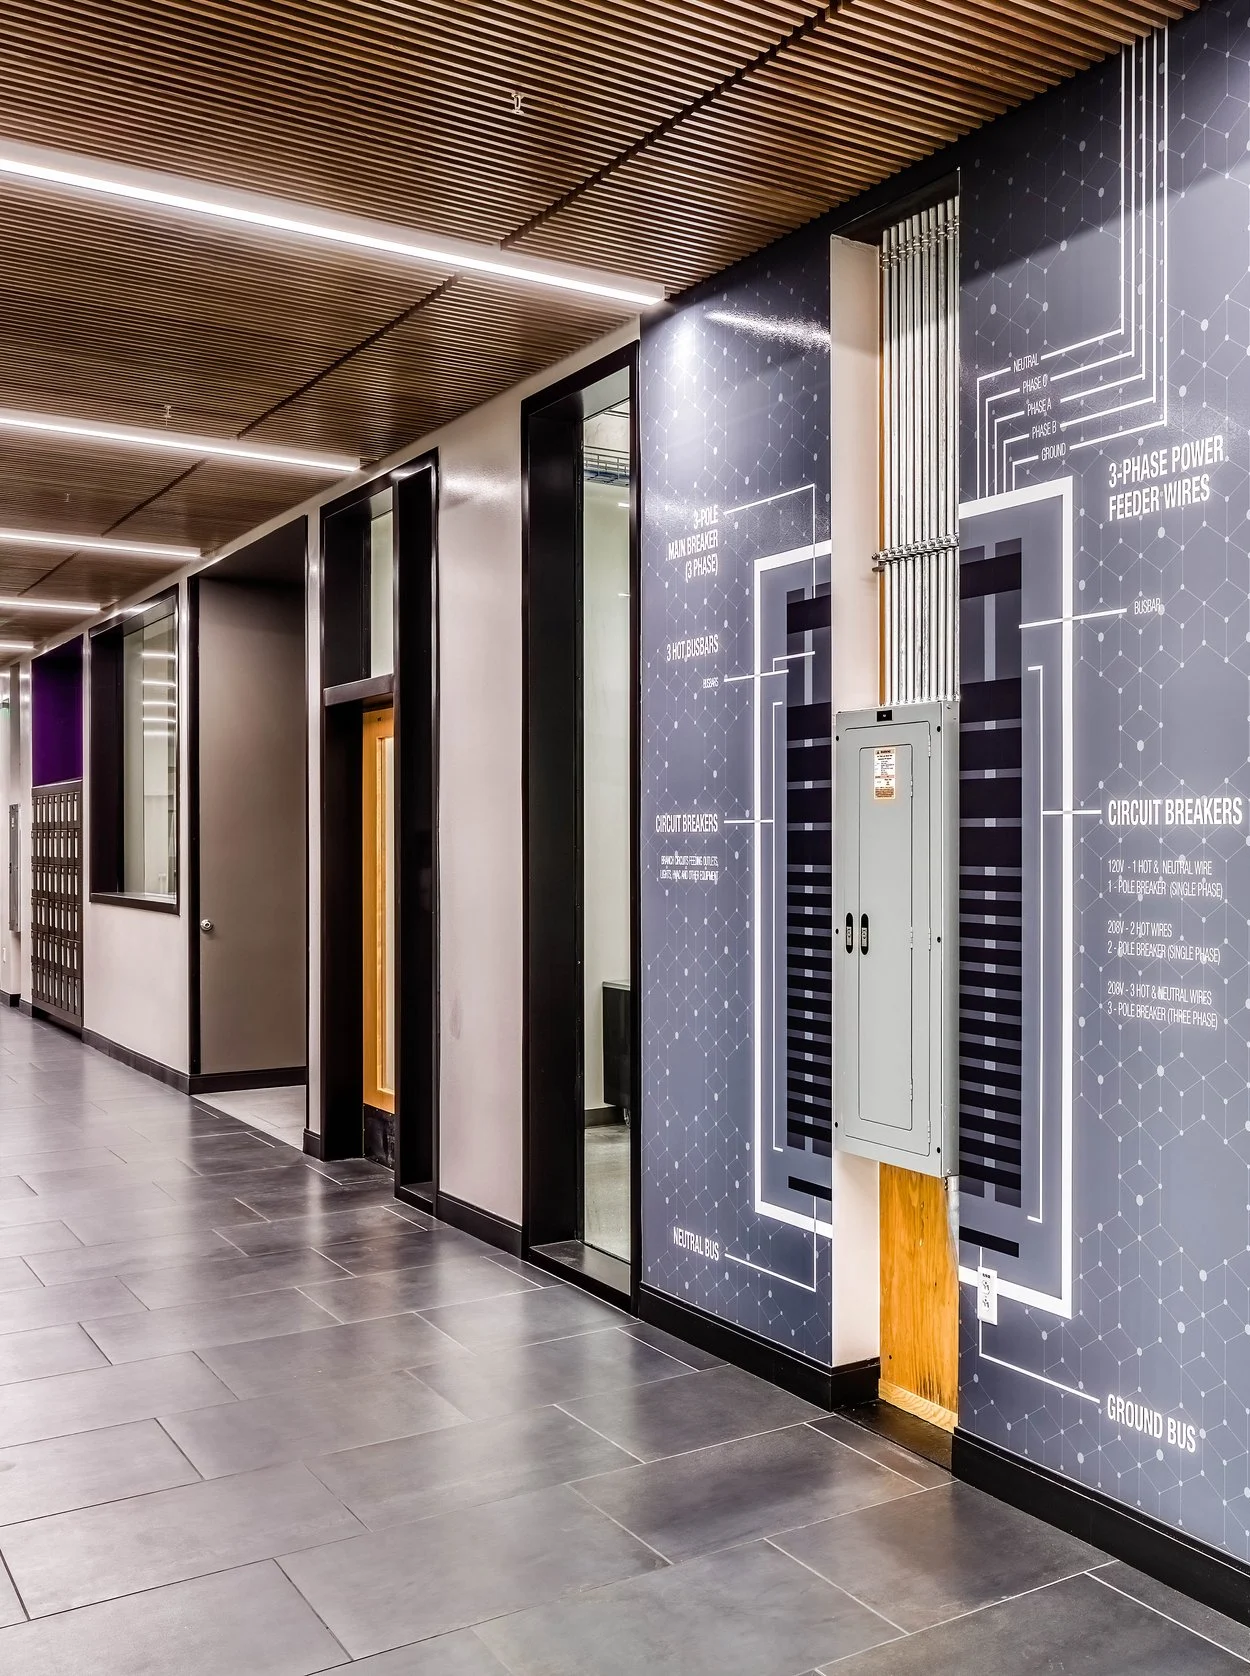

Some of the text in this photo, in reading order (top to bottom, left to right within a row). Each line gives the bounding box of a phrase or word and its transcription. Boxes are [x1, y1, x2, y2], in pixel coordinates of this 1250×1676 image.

[1014, 353, 1039, 372] NEUTRAL
[1022, 376, 1042, 394] PHASE
[1028, 397, 1052, 416] PHASE A
[1032, 420, 1056, 440] PHASE B
[1041, 442, 1066, 461] GROUND
[1108, 434, 1224, 488] 3-PHASE POWER
[1109, 474, 1210, 522] FEEDER WIRES
[694, 504, 718, 530] 3-POLE
[668, 529, 718, 560] MAIN BREAKER
[686, 553, 718, 583] (3 PHASE)
[1134, 598, 1161, 615] BUSBAR
[666, 634, 718, 661] 3 HOT BUSBARS
[656, 814, 718, 832] CIRCUIT BREAKERS
[1108, 797, 1243, 826] CIRCUIT BREAKERS
[1108, 860, 1124, 872] 120V
[1132, 860, 1136, 872] 1
[1138, 860, 1152, 874] HOT
[1154, 860, 1160, 874] &
[1162, 860, 1194, 874] NEUTRAL
[1194, 860, 1212, 876] WIRE
[1118, 880, 1136, 894] POLE
[1136, 880, 1166, 894] BREAKER
[1170, 882, 1196, 898] (SINGLE
[1198, 882, 1222, 900] PHASE)
[1130, 921, 1134, 934] 2
[1136, 921, 1150, 936] HOT
[1150, 922, 1172, 938] WIRES
[1118, 940, 1135, 956] POLE
[1136, 942, 1166, 958] BREAKER
[1168, 944, 1194, 962] (SINGLE
[1195, 946, 1220, 966] PHASE)
[1130, 983, 1134, 996] 3
[1136, 984, 1150, 998] HOT
[1152, 984, 1157, 1000] &
[1158, 986, 1188, 1002] NEUTRAL
[1190, 988, 1212, 1006] WIRES
[1118, 1002, 1136, 1018] POLE
[1136, 1004, 1166, 1020] BREAKER
[1168, 1008, 1192, 1025] (THREE
[1192, 1010, 1218, 1030] PHASE)
[673, 1226, 719, 1261] NEUTRAL BUS
[1108, 1394, 1196, 1453] GROUND BUS
